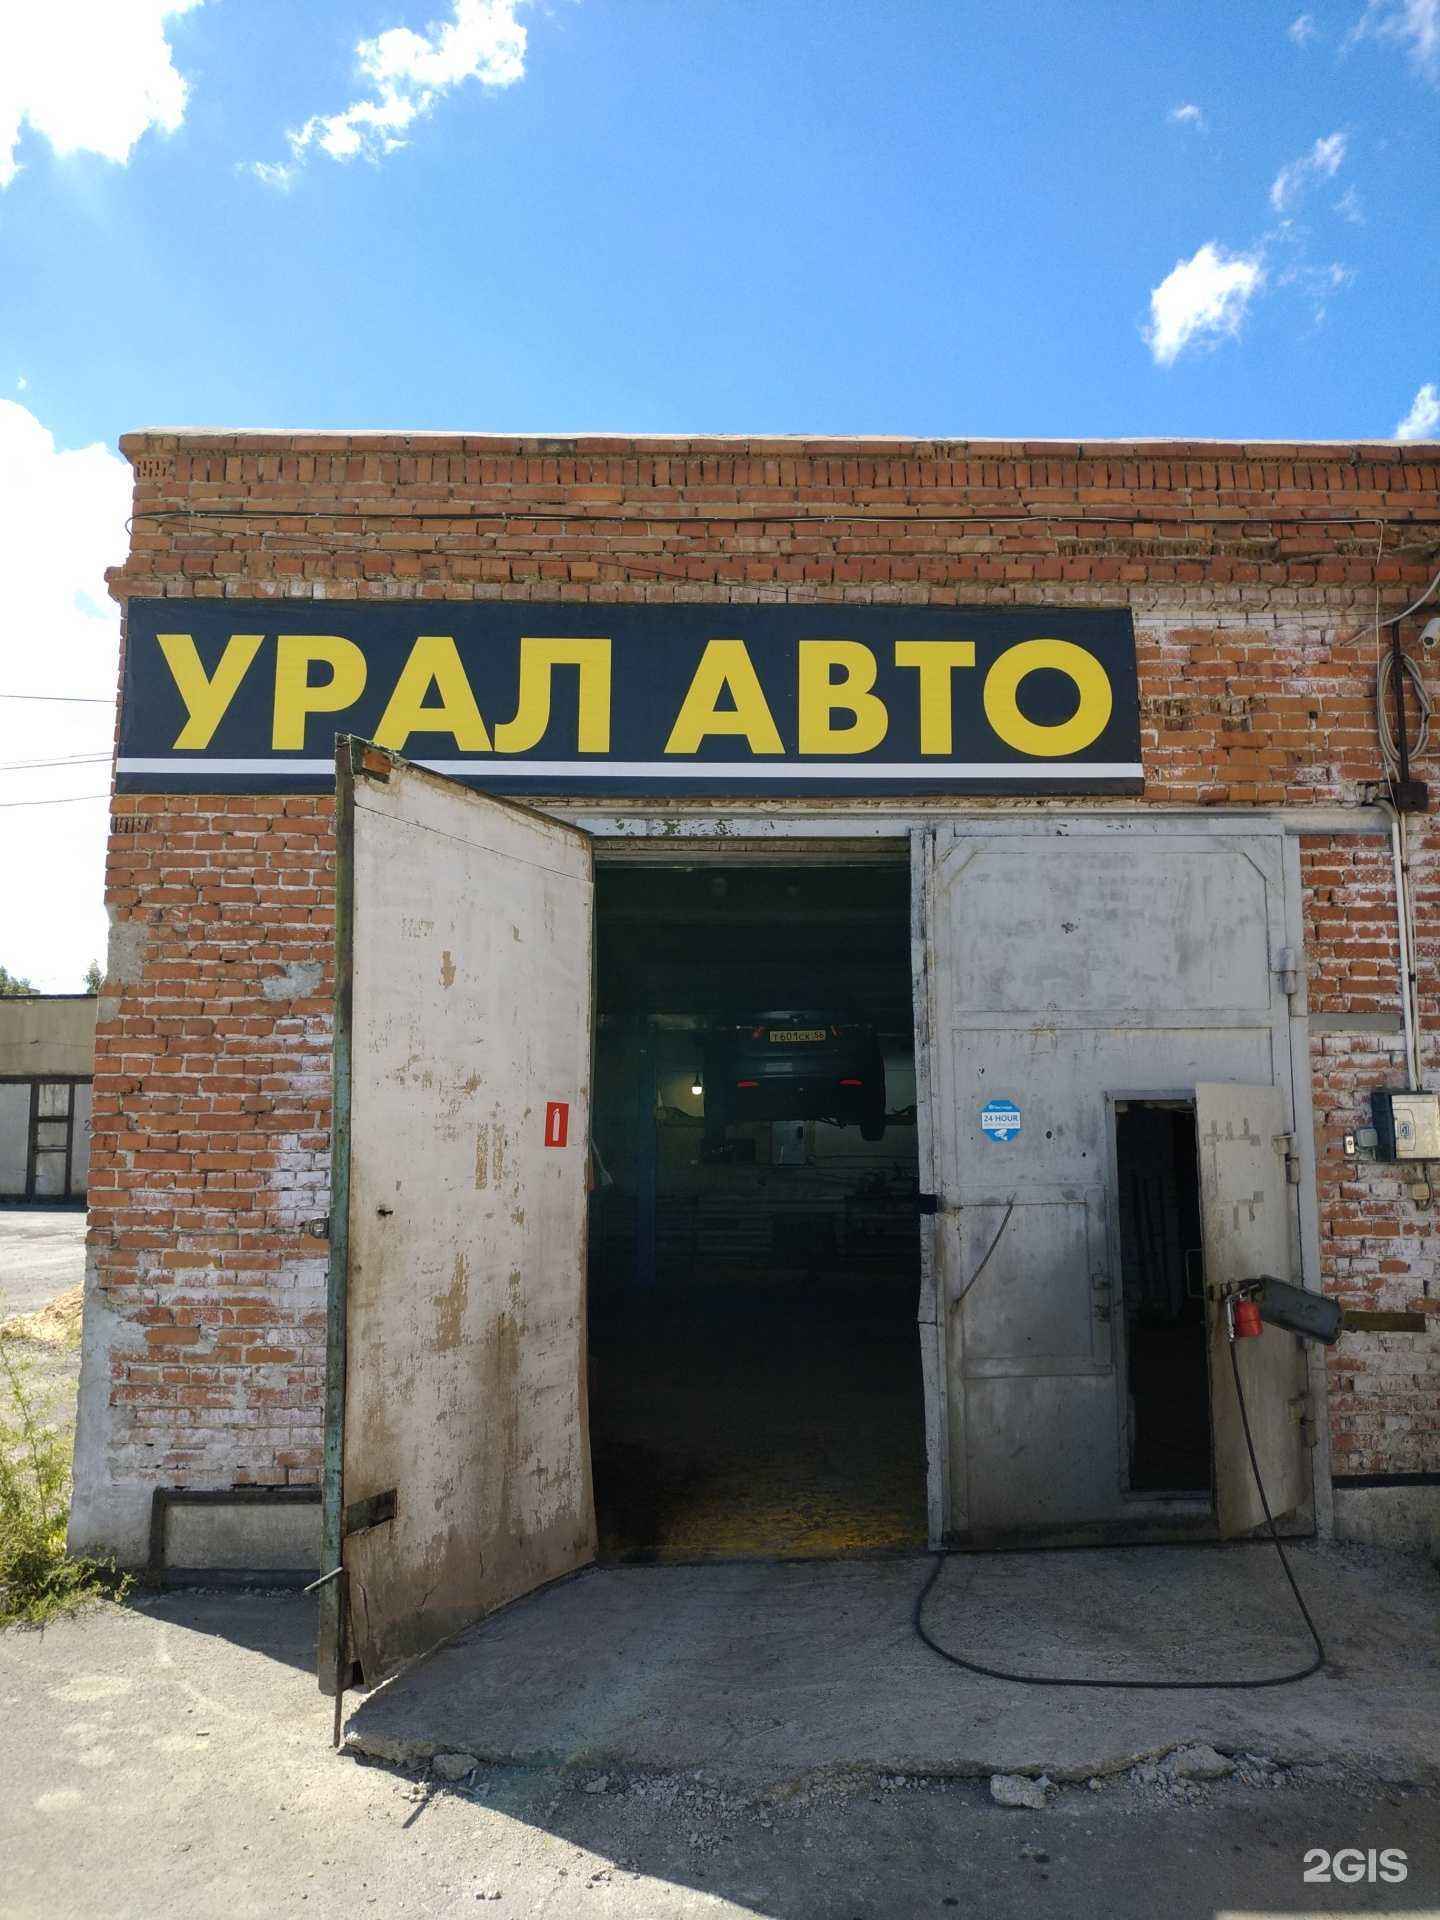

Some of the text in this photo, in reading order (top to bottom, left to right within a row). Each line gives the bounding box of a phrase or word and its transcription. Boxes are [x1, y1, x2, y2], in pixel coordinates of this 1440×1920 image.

[156, 633, 1113, 757] УРАЛ АВТО
[984, 1114, 1018, 1122] 24 HOUR
